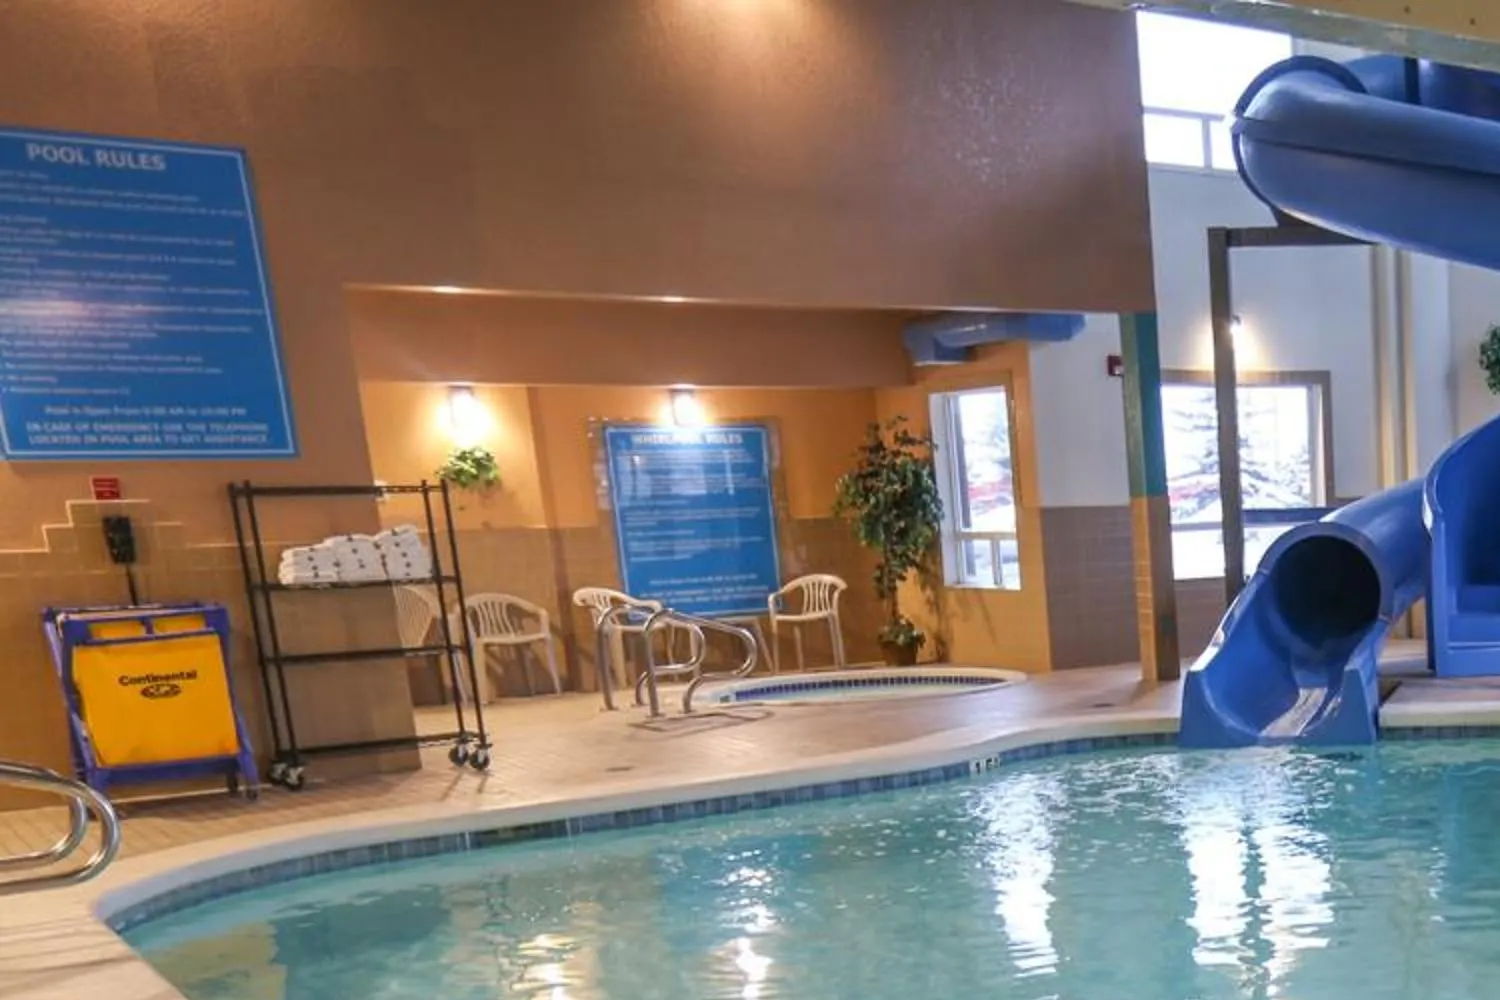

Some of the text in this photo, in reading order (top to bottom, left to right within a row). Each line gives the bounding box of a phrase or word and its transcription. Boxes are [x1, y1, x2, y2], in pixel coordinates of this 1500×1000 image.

[26, 143, 167, 171] POOL RULES
[118, 669, 198, 687] Continental
